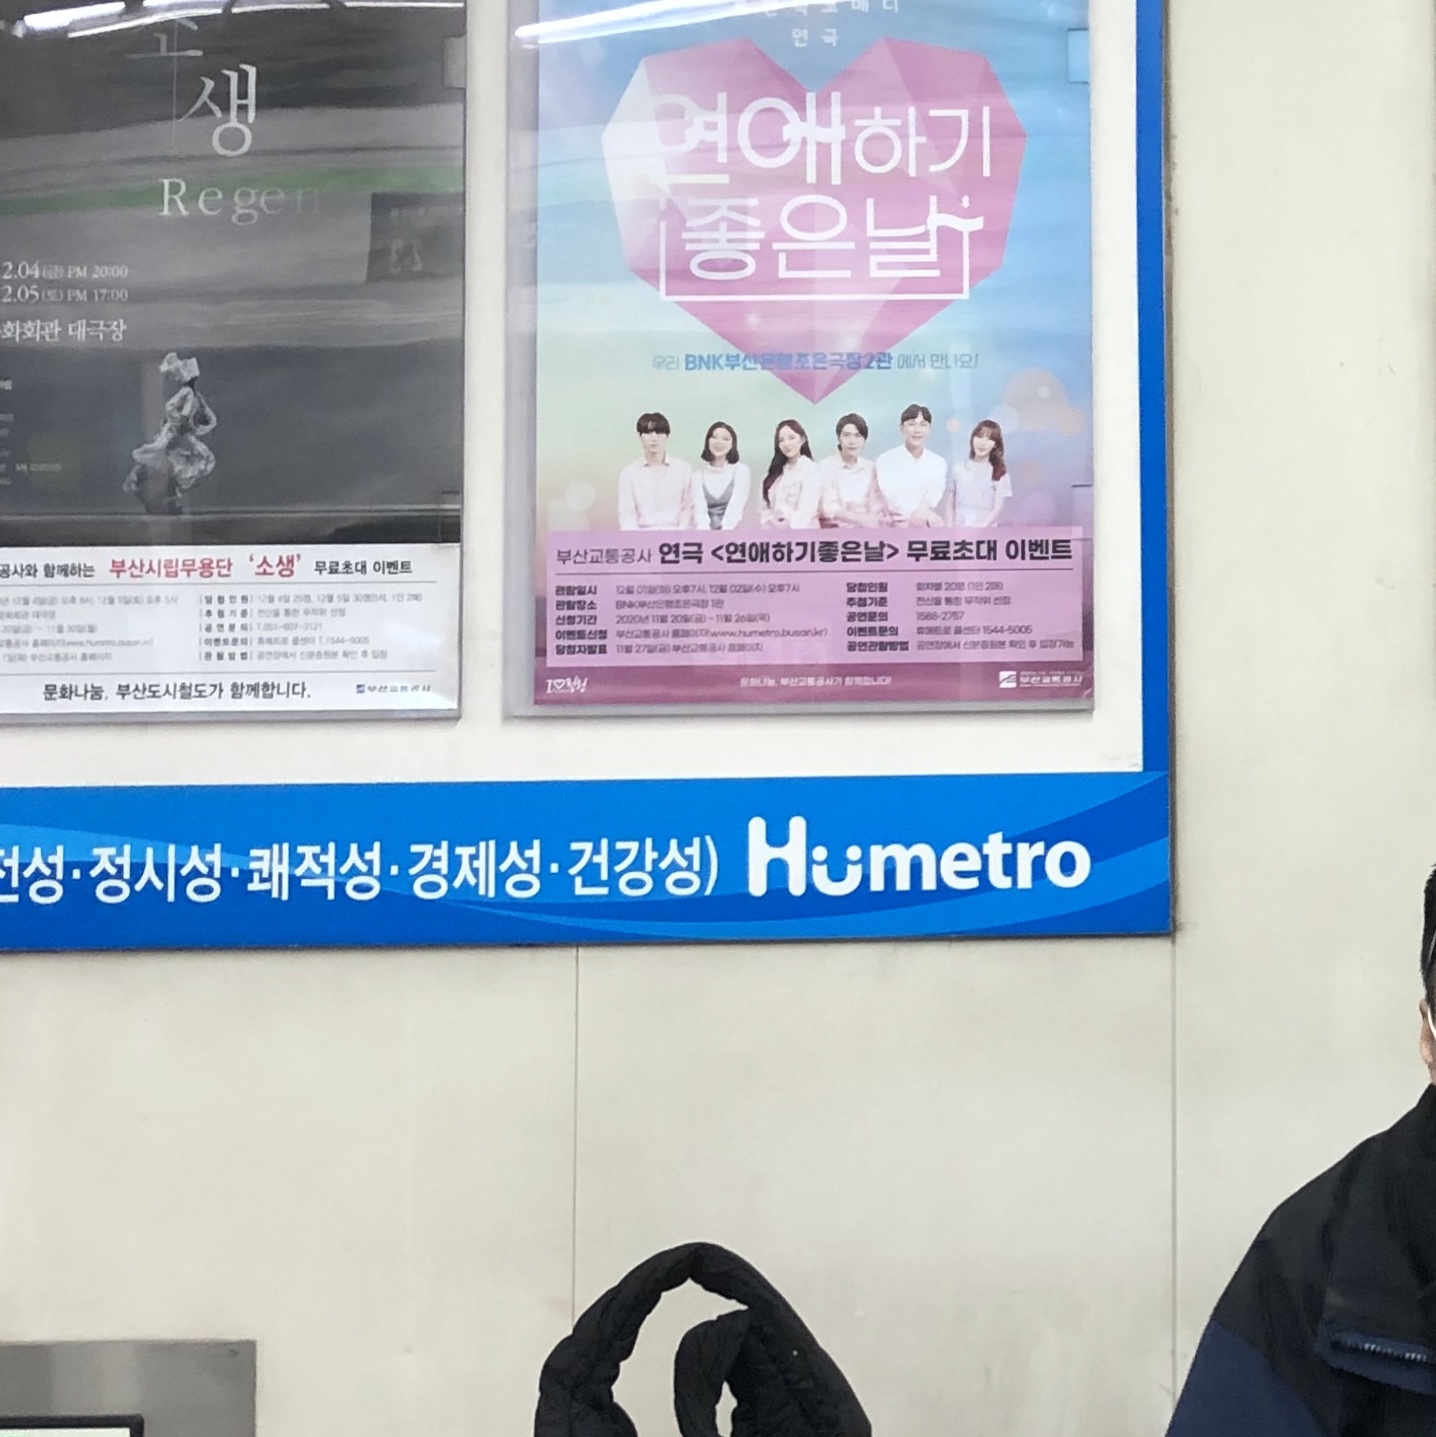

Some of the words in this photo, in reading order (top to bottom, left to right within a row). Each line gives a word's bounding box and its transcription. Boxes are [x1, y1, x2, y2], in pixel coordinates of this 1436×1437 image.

[175, 63, 258, 157] 생
[680, 194, 945, 281] 좋은날
[556, 548, 652, 566] 부산교통공사
[658, 544, 703, 565] 연극
[711, 541, 899, 564] <연애하기좋은날>
[907, 539, 998, 561] 무료초대
[1005, 537, 1073, 560] 이벤트
[0, 564, 38, 578] 공사와
[43, 563, 95, 578] 함께하는
[109, 558, 233, 579] 부산시립무용단
[314, 560, 367, 575] 무료초대
[373, 560, 412, 575] 이벤트
[43, 685, 109, 700] 문화나눔,
[115, 682, 224, 699] 부산도시철도가
[230, 682, 312, 699] 함께합니다.
